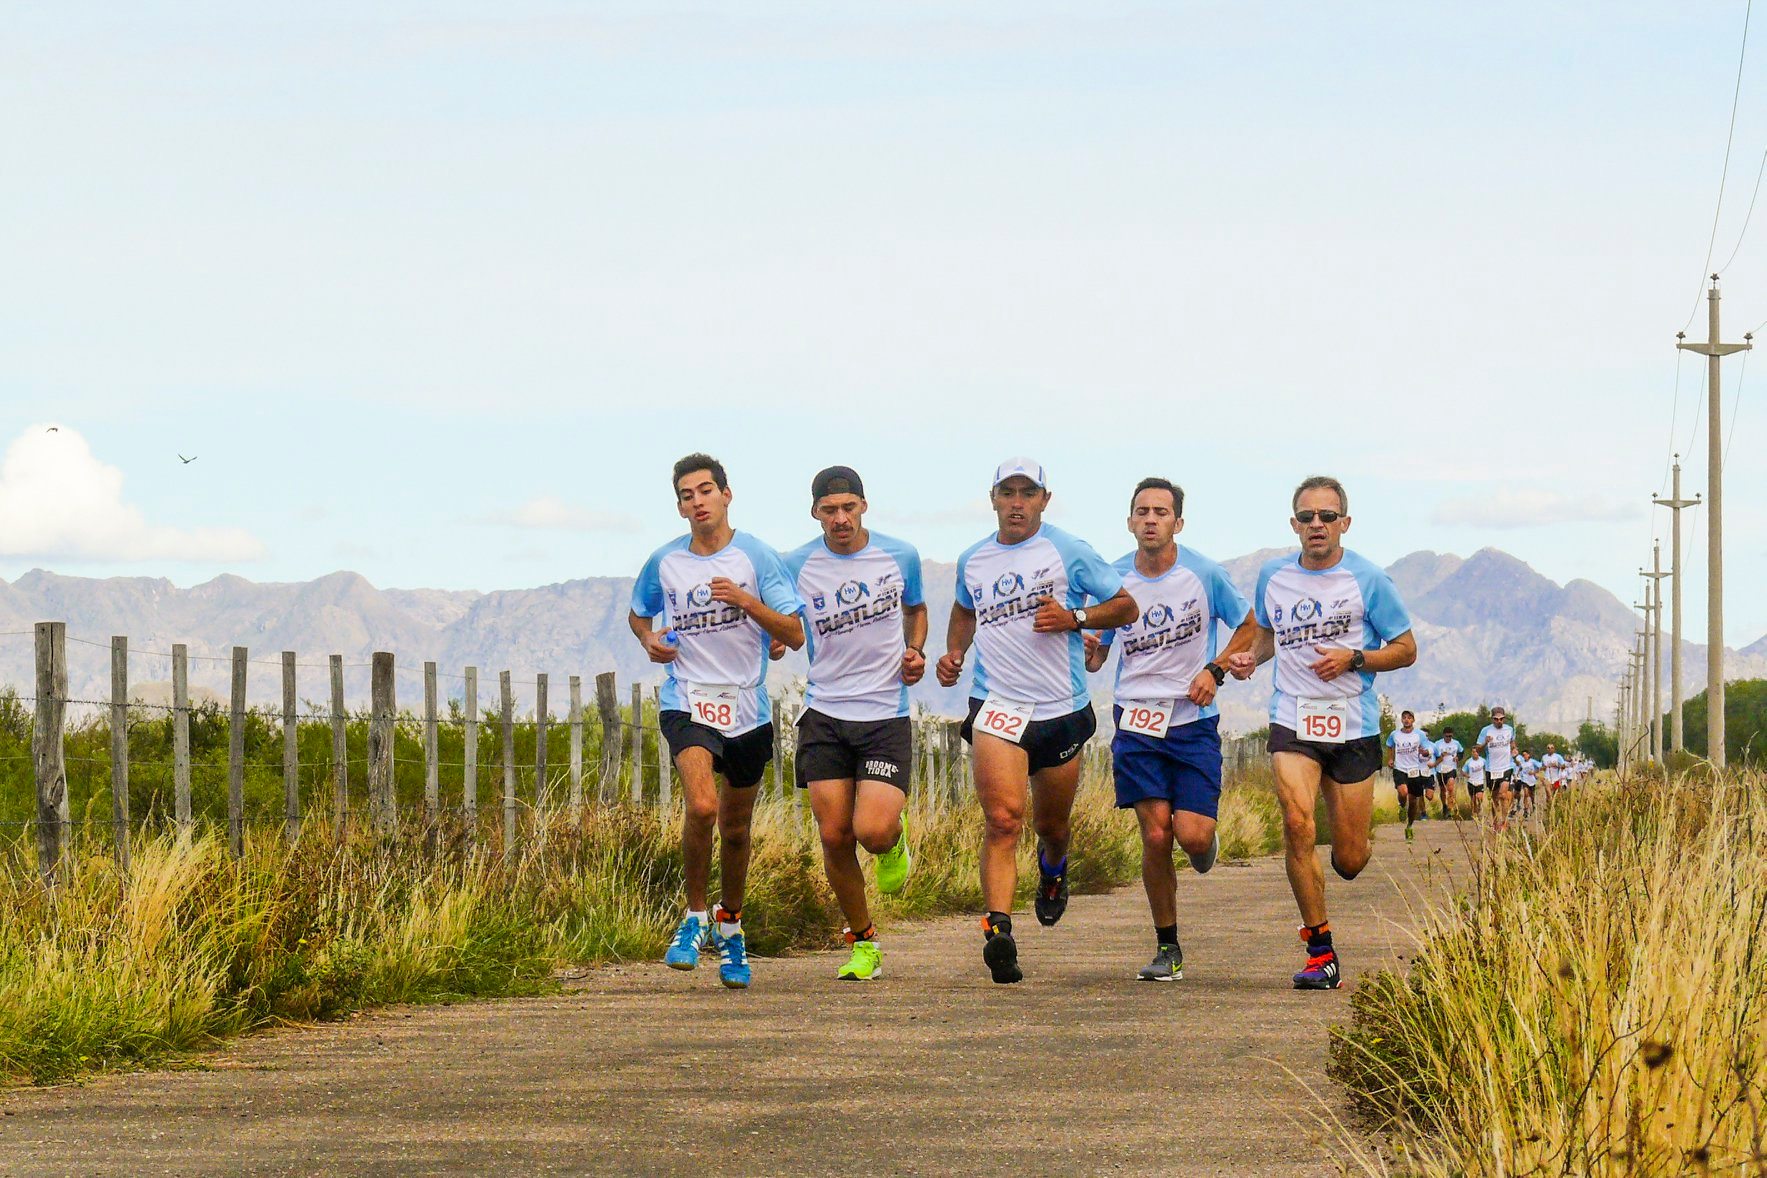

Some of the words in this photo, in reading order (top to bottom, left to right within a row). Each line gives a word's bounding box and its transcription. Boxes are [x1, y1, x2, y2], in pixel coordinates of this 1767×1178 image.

[815, 592, 898, 636] DUATLON
[1123, 617, 1201, 657] DUATLON
[694, 701, 732, 726] 168
[983, 709, 1023, 737] 162
[1128, 707, 1166, 733] 192
[1302, 715, 1342, 738] 159
